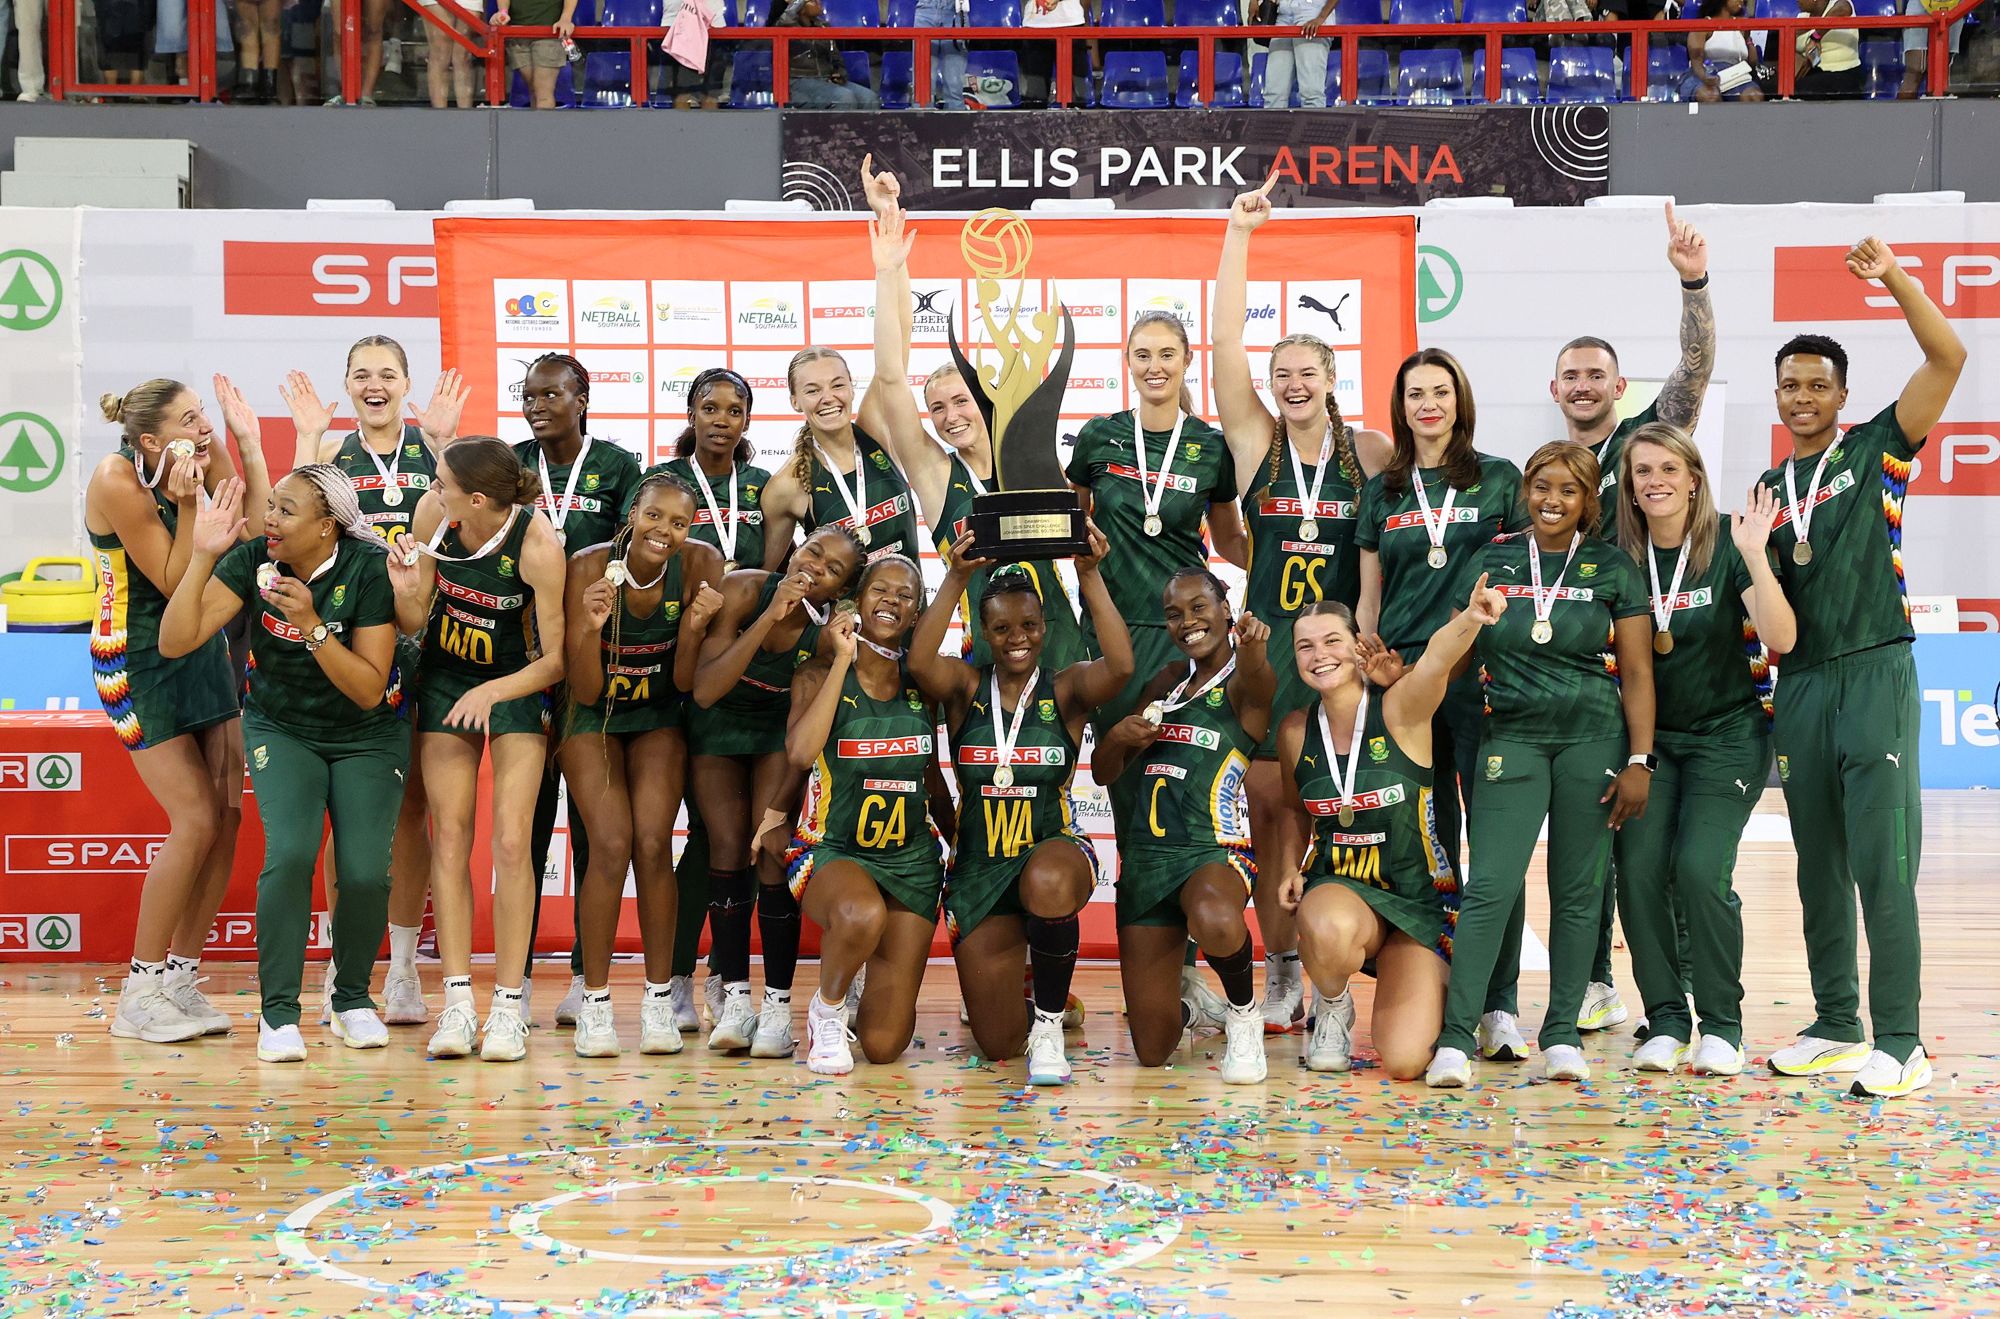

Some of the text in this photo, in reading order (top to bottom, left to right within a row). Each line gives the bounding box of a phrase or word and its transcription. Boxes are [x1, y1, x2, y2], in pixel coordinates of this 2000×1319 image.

[932, 144, 1463, 189] ELLIS PARK ARENA
[581, 311, 640, 322] NETBALL
[738, 312, 797, 323] NETBALL
[824, 307, 865, 317] SPAR
[590, 373, 630, 382] SPAR
[746, 378, 788, 388] SPAR
[535, 496, 580, 509] SAR
[844, 502, 895, 530] SAR
[1291, 543, 1324, 553] SPAR
[1279, 555, 1327, 611] GS
[438, 578, 498, 608] SPAR
[274, 622, 304, 639] SP
[440, 614, 493, 664] WD
[1161, 727, 1193, 742] AR
[857, 740, 919, 755] SPAR
[1151, 765, 1174, 775] SPAR
[873, 781, 905, 790] SPAR
[991, 787, 1023, 796] SPAR
[1149, 777, 1167, 837] C
[855, 794, 906, 849] GA
[983, 798, 1035, 858] WA
[1341, 835, 1373, 843] SPAR
